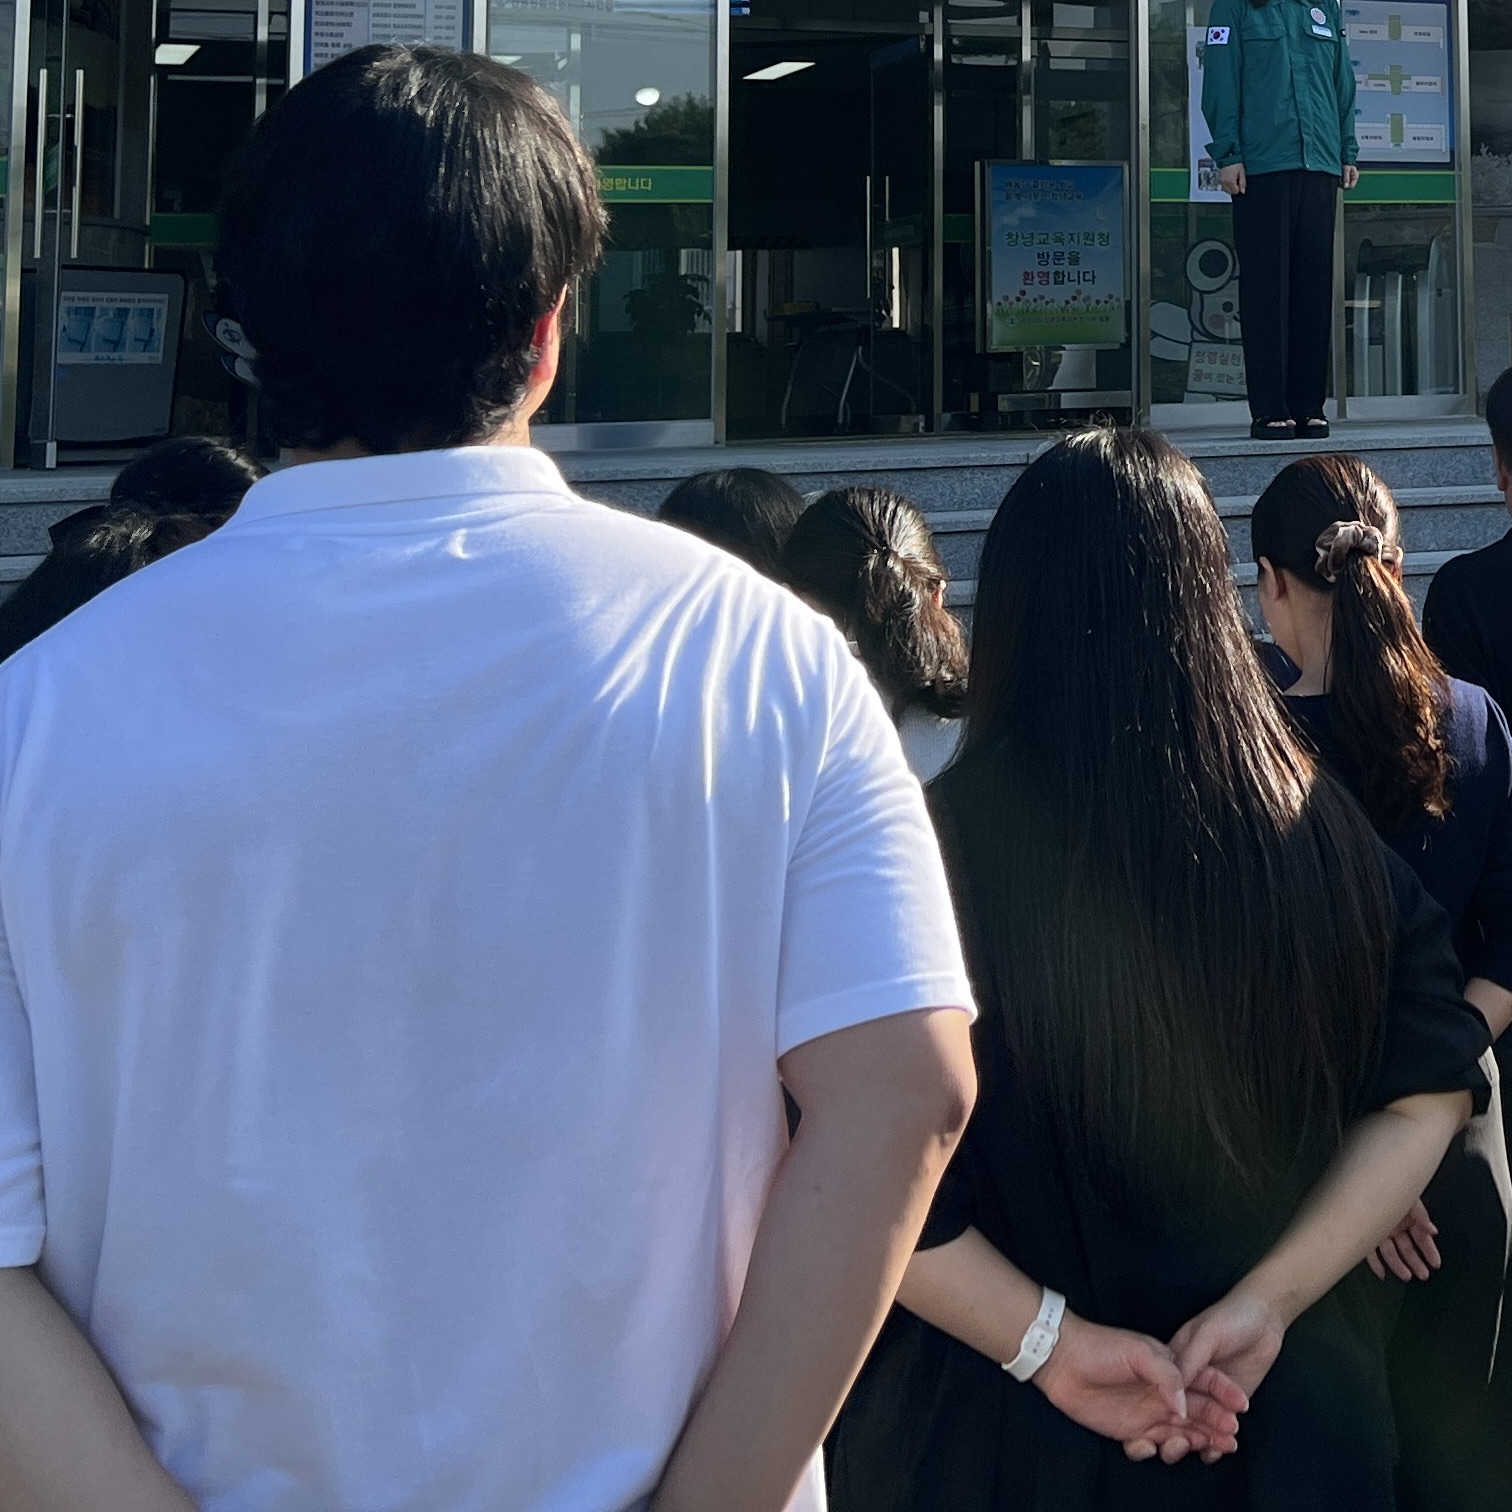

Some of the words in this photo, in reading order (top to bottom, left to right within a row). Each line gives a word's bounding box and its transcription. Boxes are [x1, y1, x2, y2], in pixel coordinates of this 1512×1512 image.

[1005, 231, 1111, 248] 창녕교육지원청
[1037, 251, 1081, 266] 방문을
[1022, 269, 1097, 286] 환영합니다
